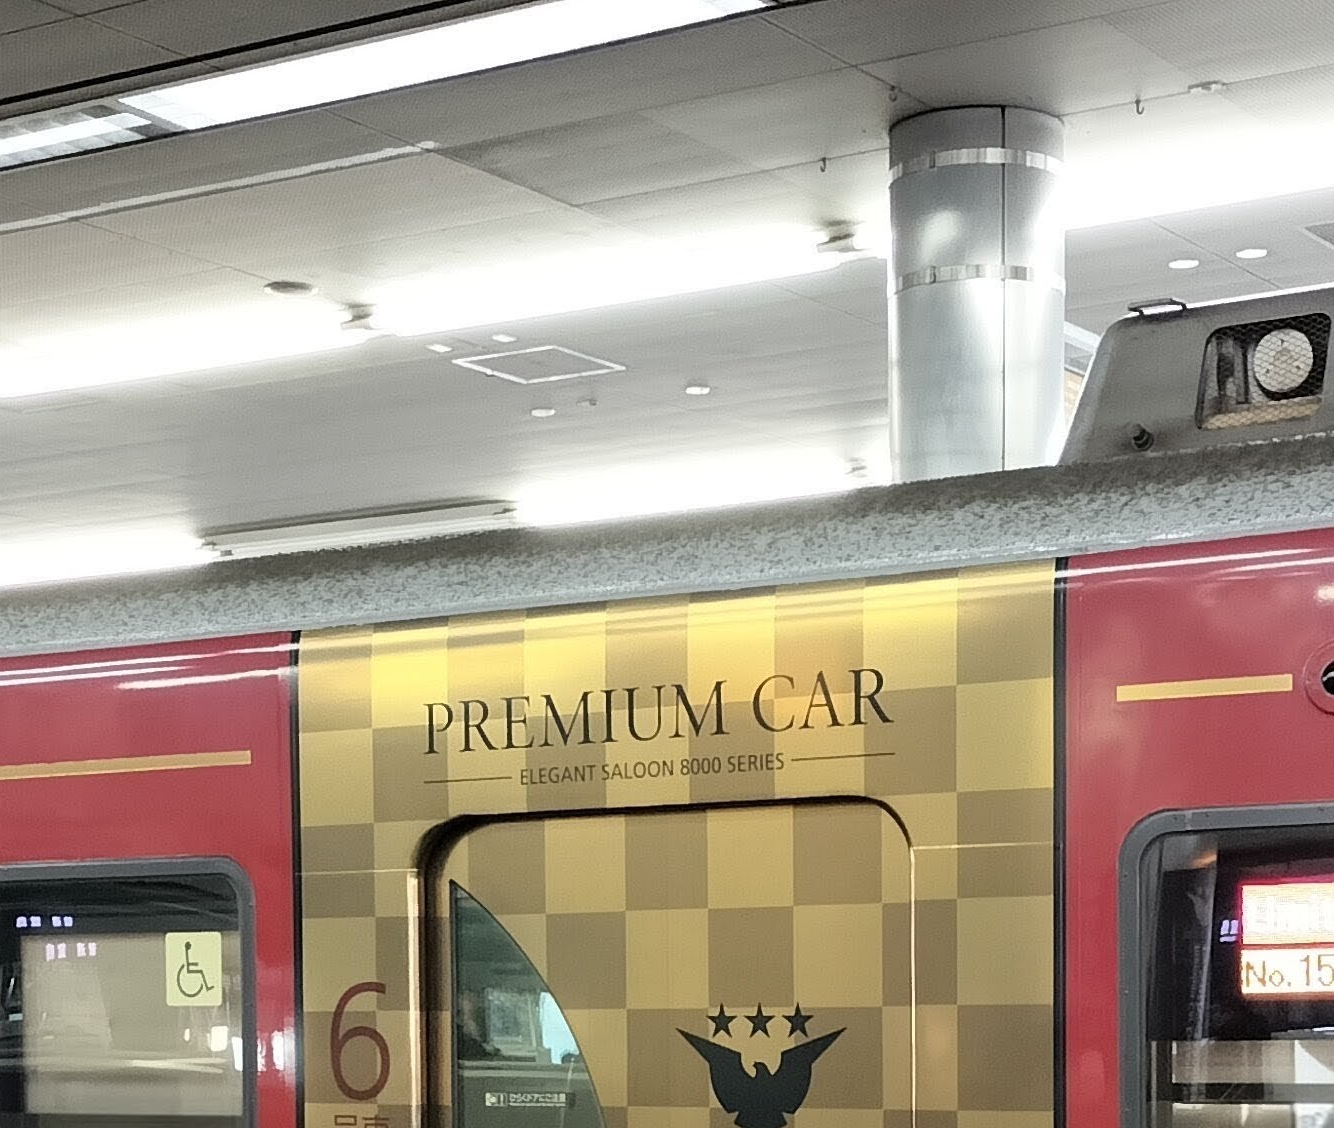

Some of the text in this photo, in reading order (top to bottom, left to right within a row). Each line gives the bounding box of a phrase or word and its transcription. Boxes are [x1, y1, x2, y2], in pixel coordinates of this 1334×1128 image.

[423, 668, 895, 755] PREMIUM CAR
[520, 752, 785, 786] ELEGANT SALOON 8000 SERIES
[330, 981, 390, 1101] 6
